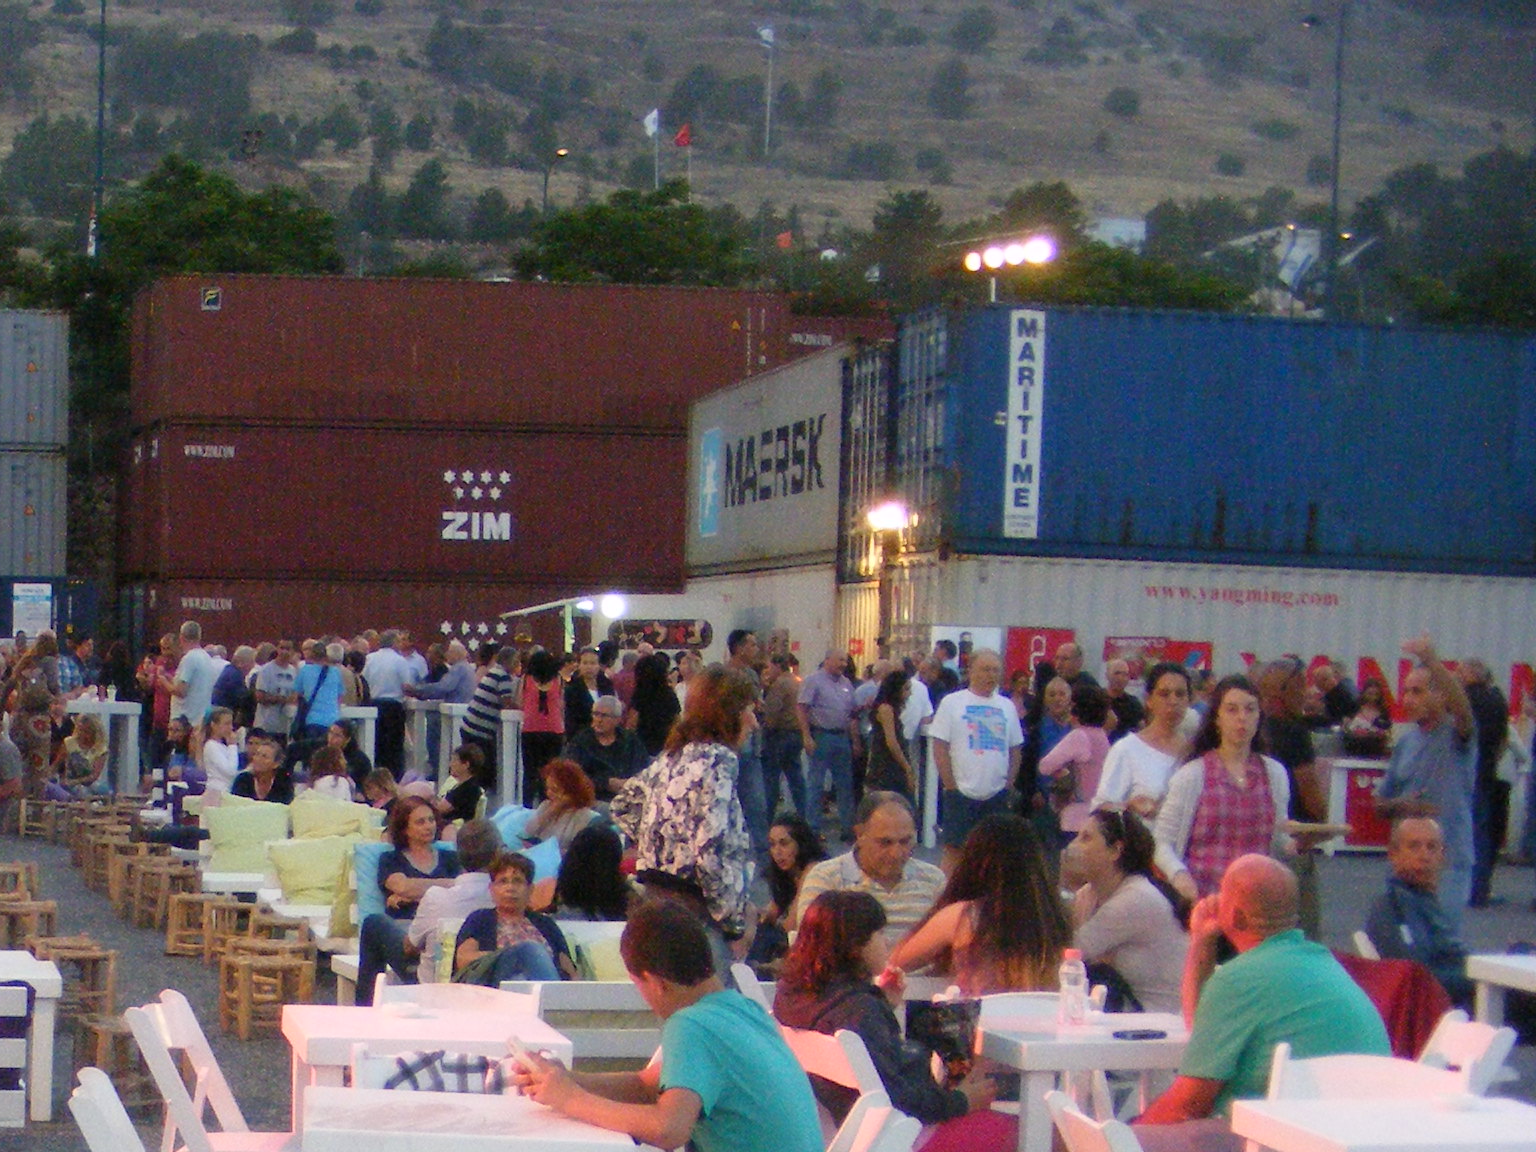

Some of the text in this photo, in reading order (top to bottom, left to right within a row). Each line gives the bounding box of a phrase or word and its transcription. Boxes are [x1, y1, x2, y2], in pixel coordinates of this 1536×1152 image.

[1011, 317, 1038, 507] MARITIME
[724, 413, 827, 508] MAERSK
[442, 511, 511, 540] ZIM
